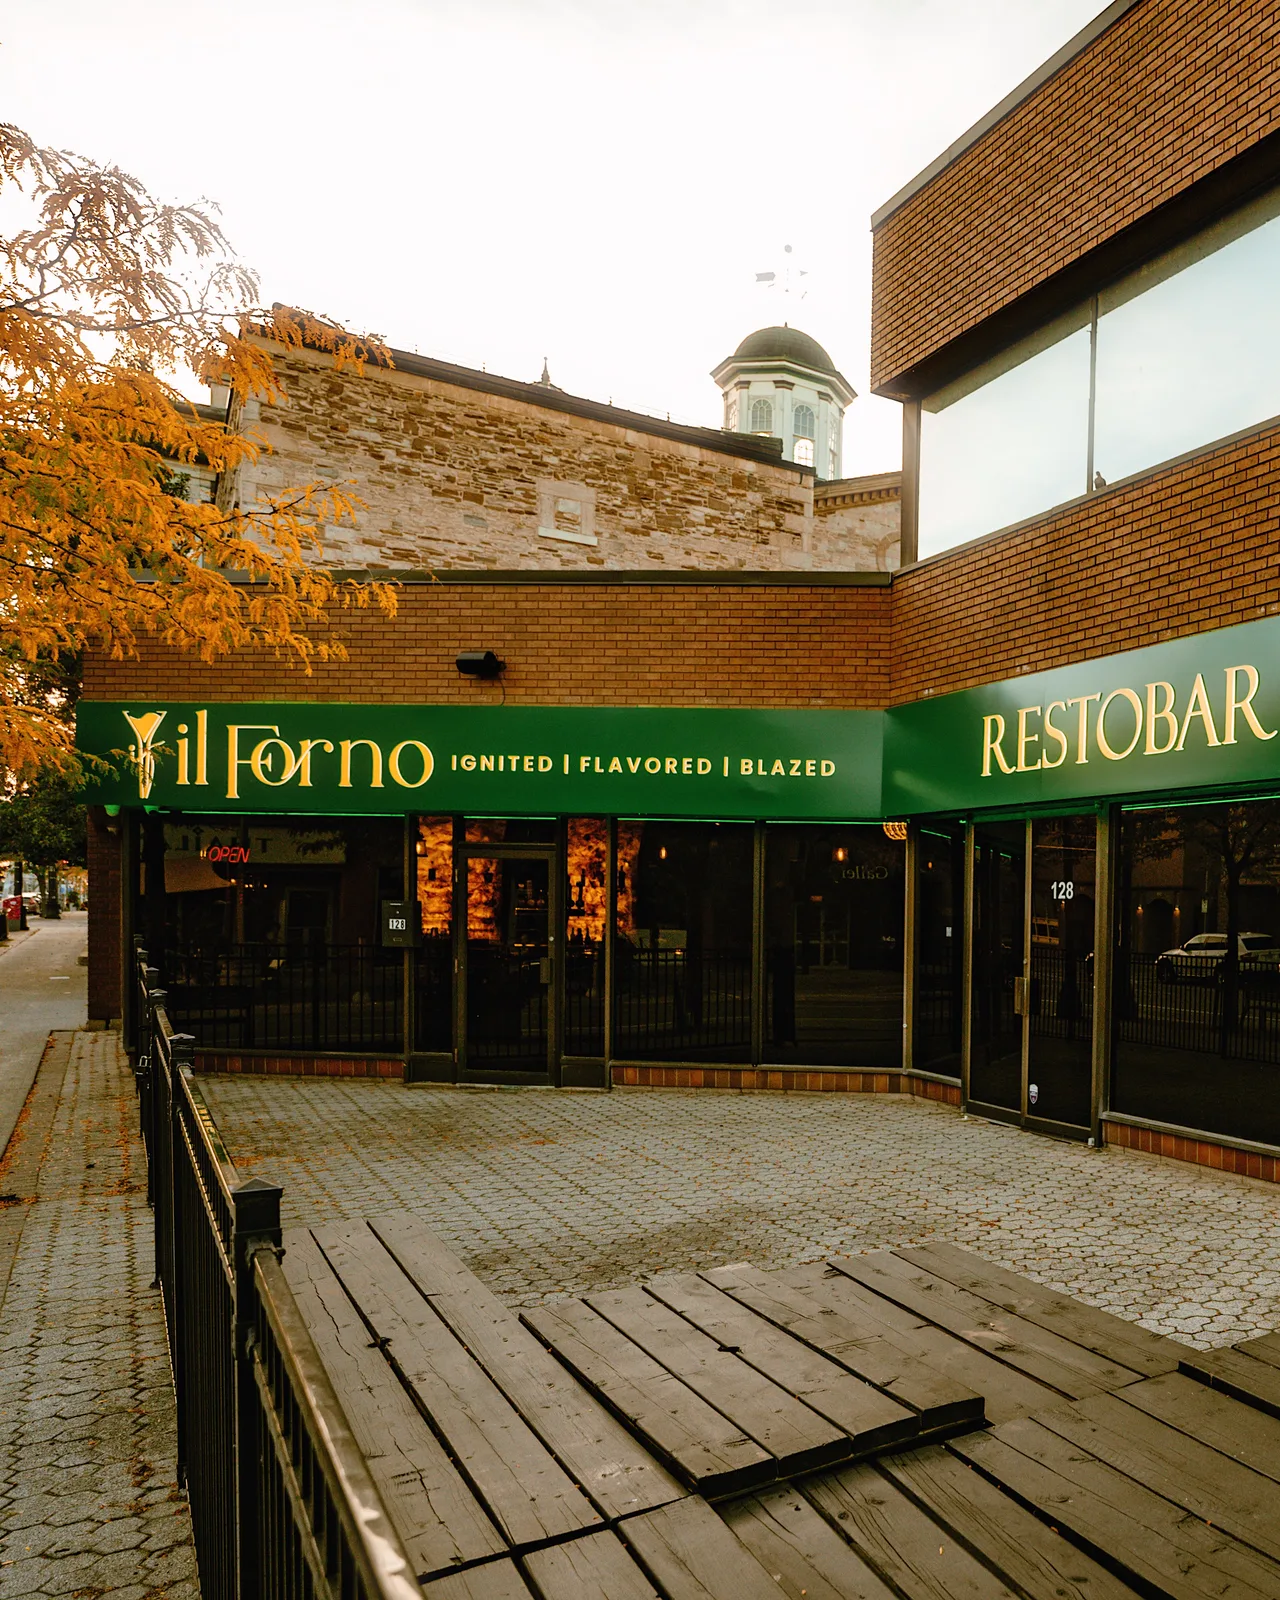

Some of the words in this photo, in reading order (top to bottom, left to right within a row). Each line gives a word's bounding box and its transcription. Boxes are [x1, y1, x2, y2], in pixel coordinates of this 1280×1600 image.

[981, 664, 1278, 777] RESTOBAR
[176, 709, 209, 786] il
[225, 724, 435, 799] Forno
[451, 754, 553, 772] IGNITED
[579, 756, 712, 775] FLAVORED
[740, 758, 836, 777] BLAZED
[208, 846, 251, 863] OPEN
[1051, 881, 1074, 900] 128
[390, 919, 406, 930] 128
